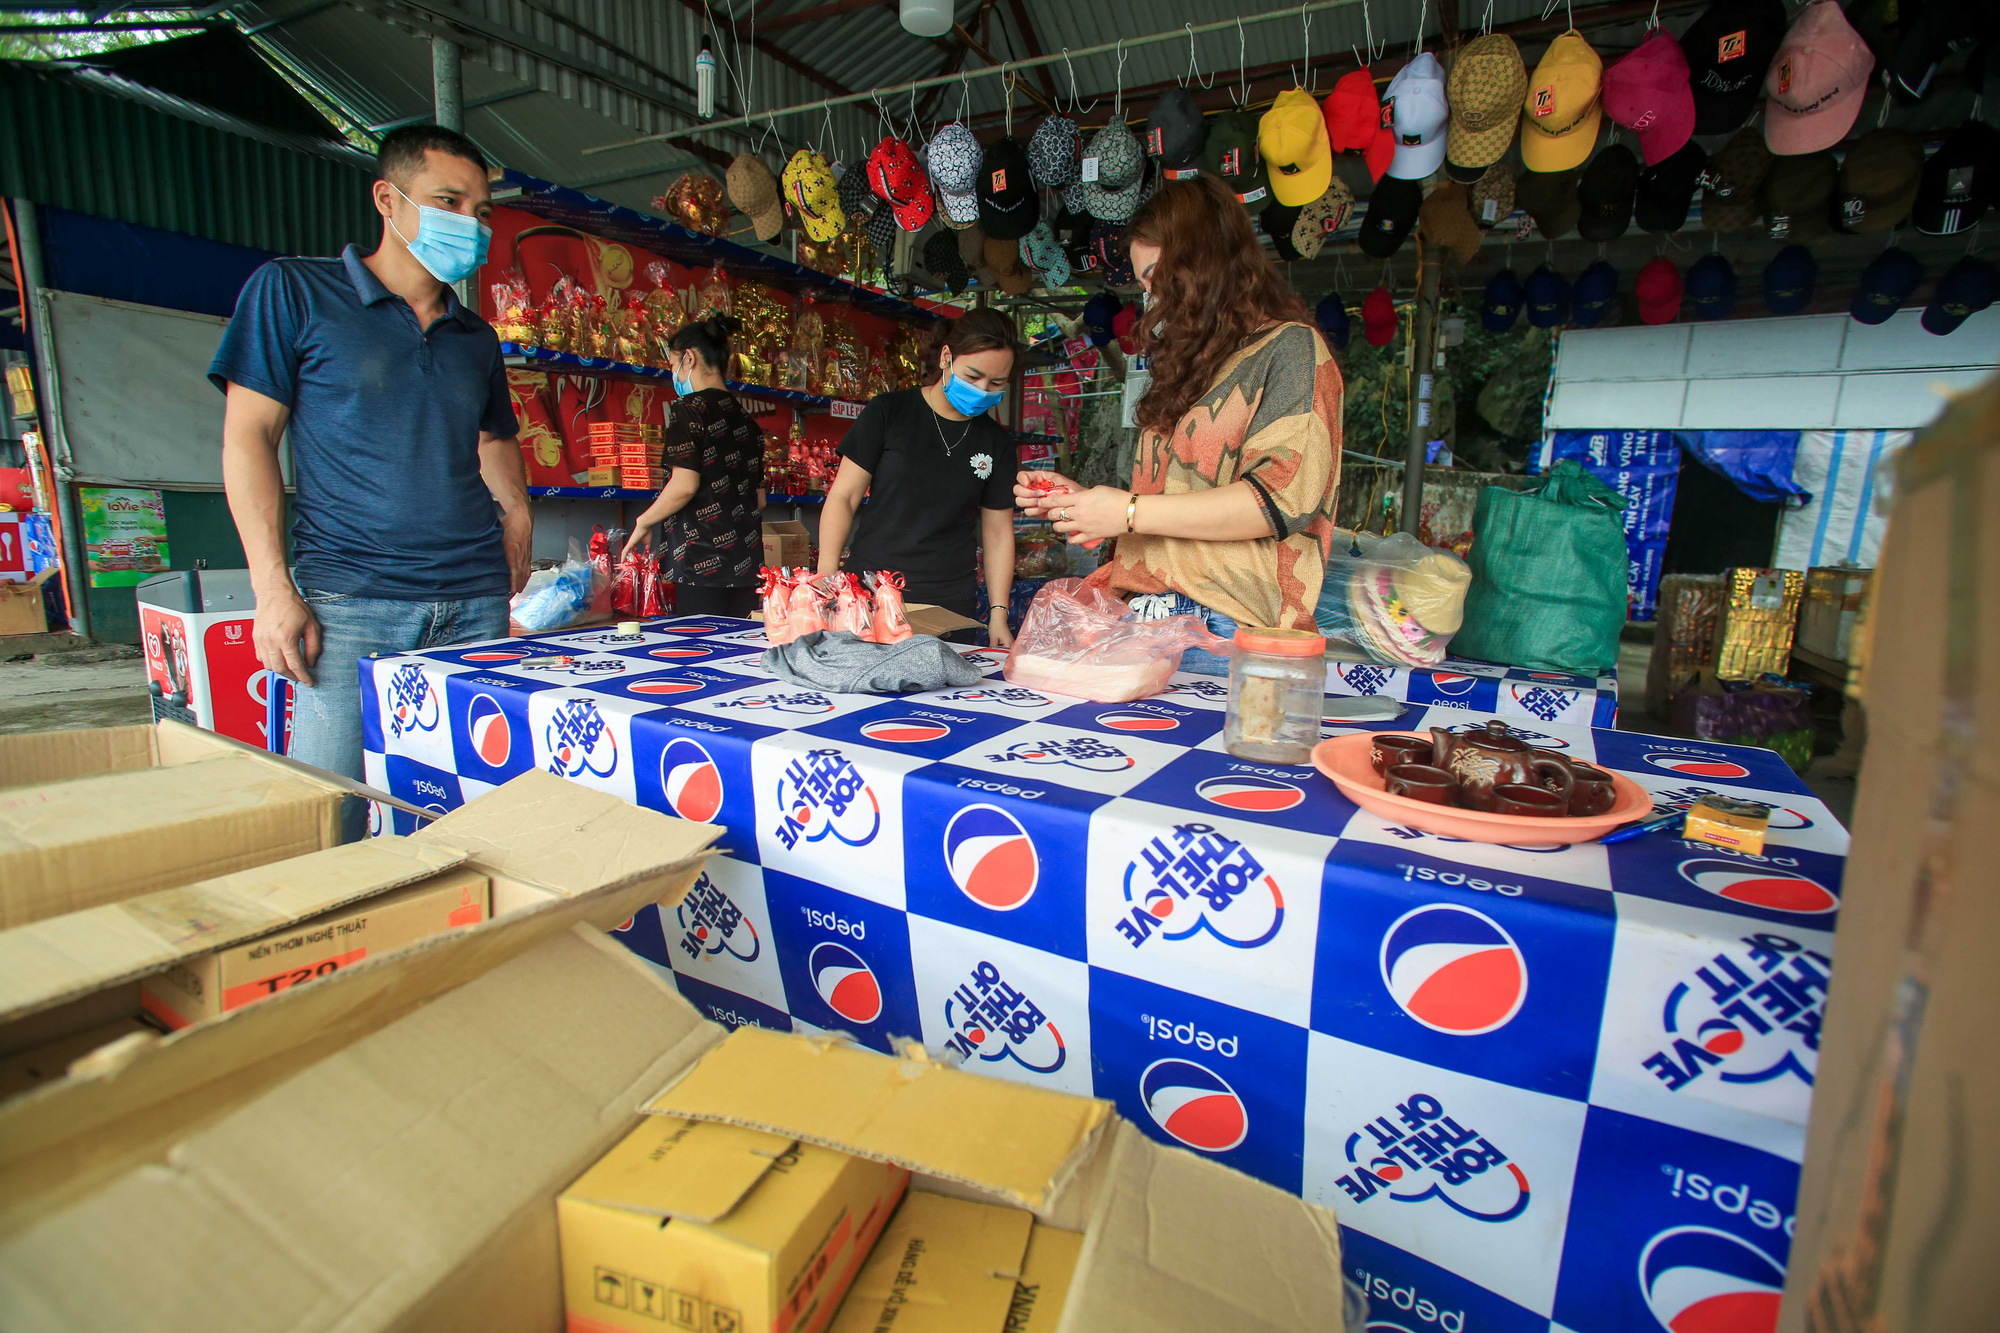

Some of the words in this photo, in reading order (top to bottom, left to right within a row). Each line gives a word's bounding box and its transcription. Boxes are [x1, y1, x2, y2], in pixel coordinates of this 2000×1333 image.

[107, 501, 139, 512] laVie
[696, 502, 720, 517] GUCCI
[713, 530, 737, 545] GUCCI
[694, 556, 720, 571] GUCCI
[1343, 664, 1367, 686] FOR
[1352, 669, 1376, 692] THE
[1374, 672, 1388, 687] IT
[412, 673, 429, 711] FOR
[1518, 687, 1546, 709] FOR
[1528, 691, 1557, 716] THE
[1555, 695, 1571, 711] IT
[551, 706, 568, 733] IT
[665, 717, 732, 733] pepsi
[909, 710, 976, 724] pepsi
[1127, 702, 1193, 716] pepsi
[580, 711, 606, 754] FOR
[1648, 743, 1727, 757] pepsi
[785, 758, 808, 791] IT
[806, 755, 851, 799] THE
[1229, 764, 1314, 778] pepsi
[416, 780, 447, 799] pepsi
[824, 764, 864, 817] FOR
[957, 779, 1045, 799] pepsi
[1172, 823, 1215, 850] OF
[1140, 836, 1176, 878] IT
[1172, 833, 1241, 890] THE
[1197, 847, 1264, 912] FOR
[1404, 864, 1524, 897] pepsi
[699, 884, 728, 924] THE
[714, 898, 743, 938] FOR
[248, 944, 271, 962] NẾN
[273, 936, 304, 952] THƠM
[306, 927, 334, 944] NGHỆ
[336, 919, 368, 936] THUẬT
[806, 908, 866, 941] pepsi
[1740, 933, 1802, 974] OF
[258, 961, 339, 994] T20
[970, 961, 1000, 996] OF
[1695, 953, 1755, 1006] IT
[953, 983, 980, 1014] IT
[979, 981, 1026, 1028] THE
[999, 999, 1047, 1045] FOR
[1148, 1015, 1239, 1058] pepsi
[1395, 1093, 1443, 1132] OF
[1364, 1116, 1406, 1150] IT
[1401, 1115, 1480, 1165] THE
[1429, 1137, 1508, 1186] FOR
[1363, 1272, 1465, 1333] pepsi
